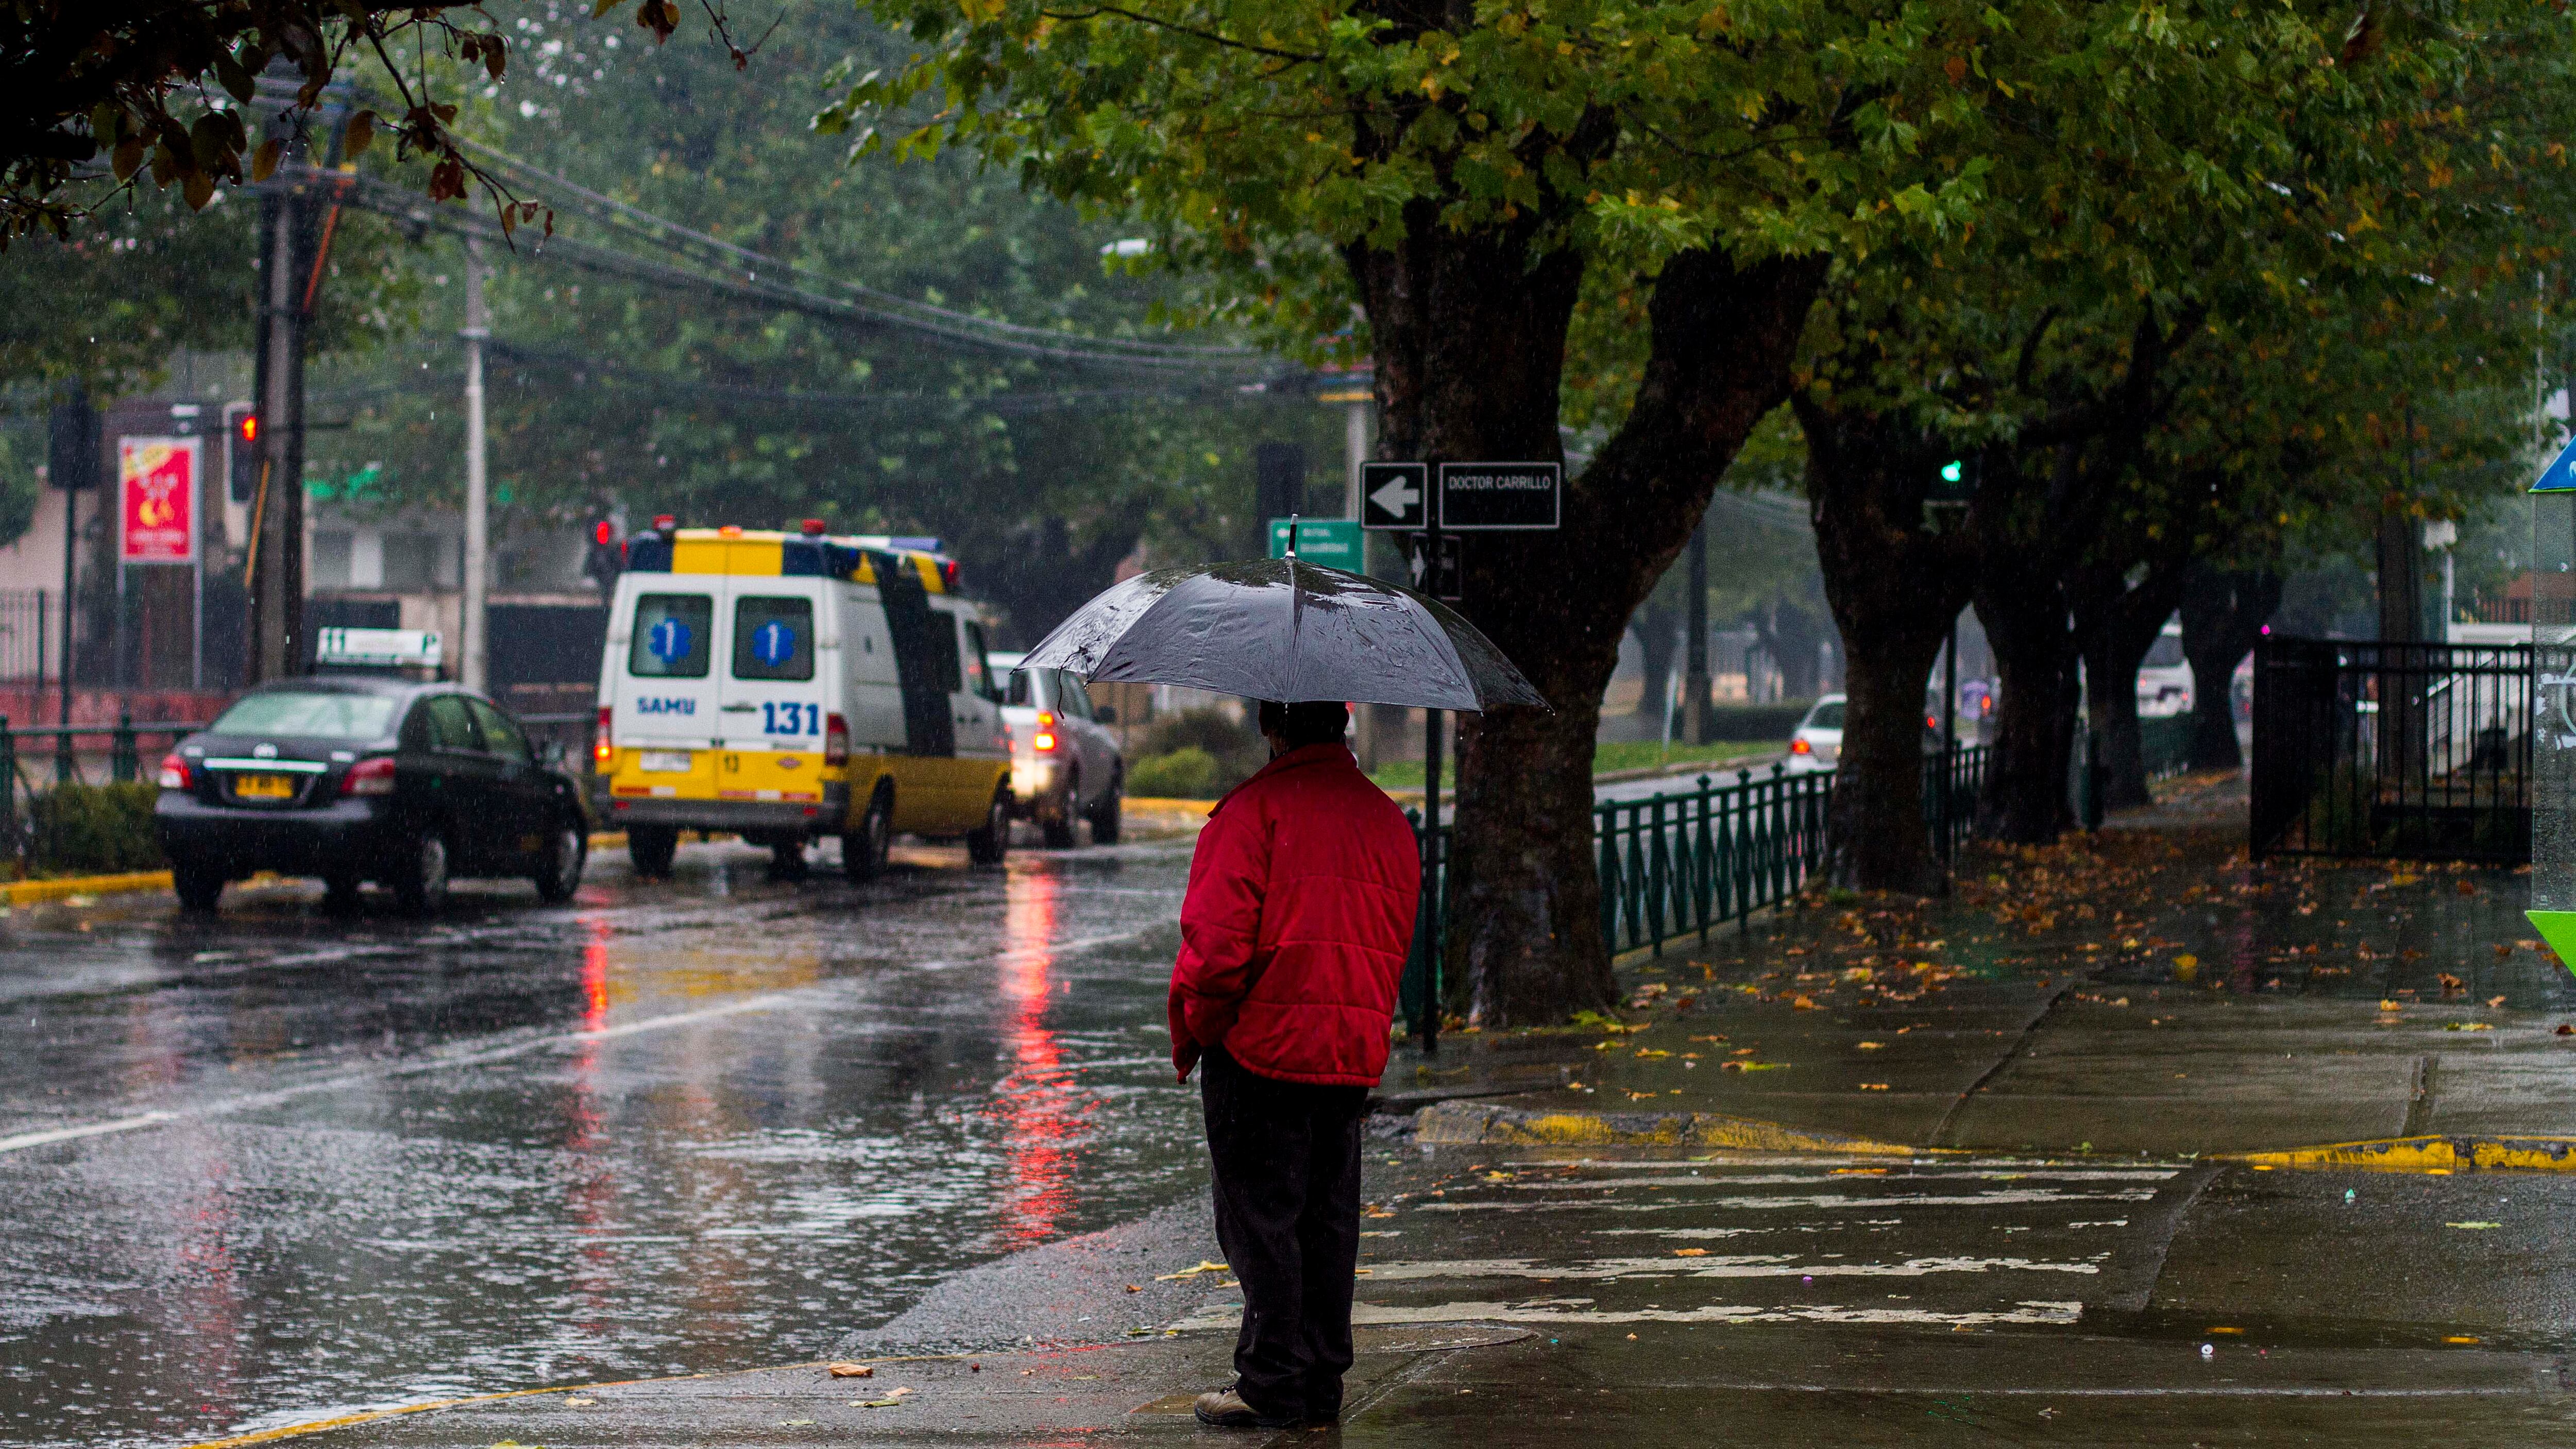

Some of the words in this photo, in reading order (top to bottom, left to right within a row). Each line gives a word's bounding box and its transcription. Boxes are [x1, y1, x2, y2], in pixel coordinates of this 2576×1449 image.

[1449, 476, 1493, 489] DOCTOR
[1496, 476, 1551, 489] CARRILLO
[637, 697, 696, 714] SAMU
[762, 701, 819, 735] 131
